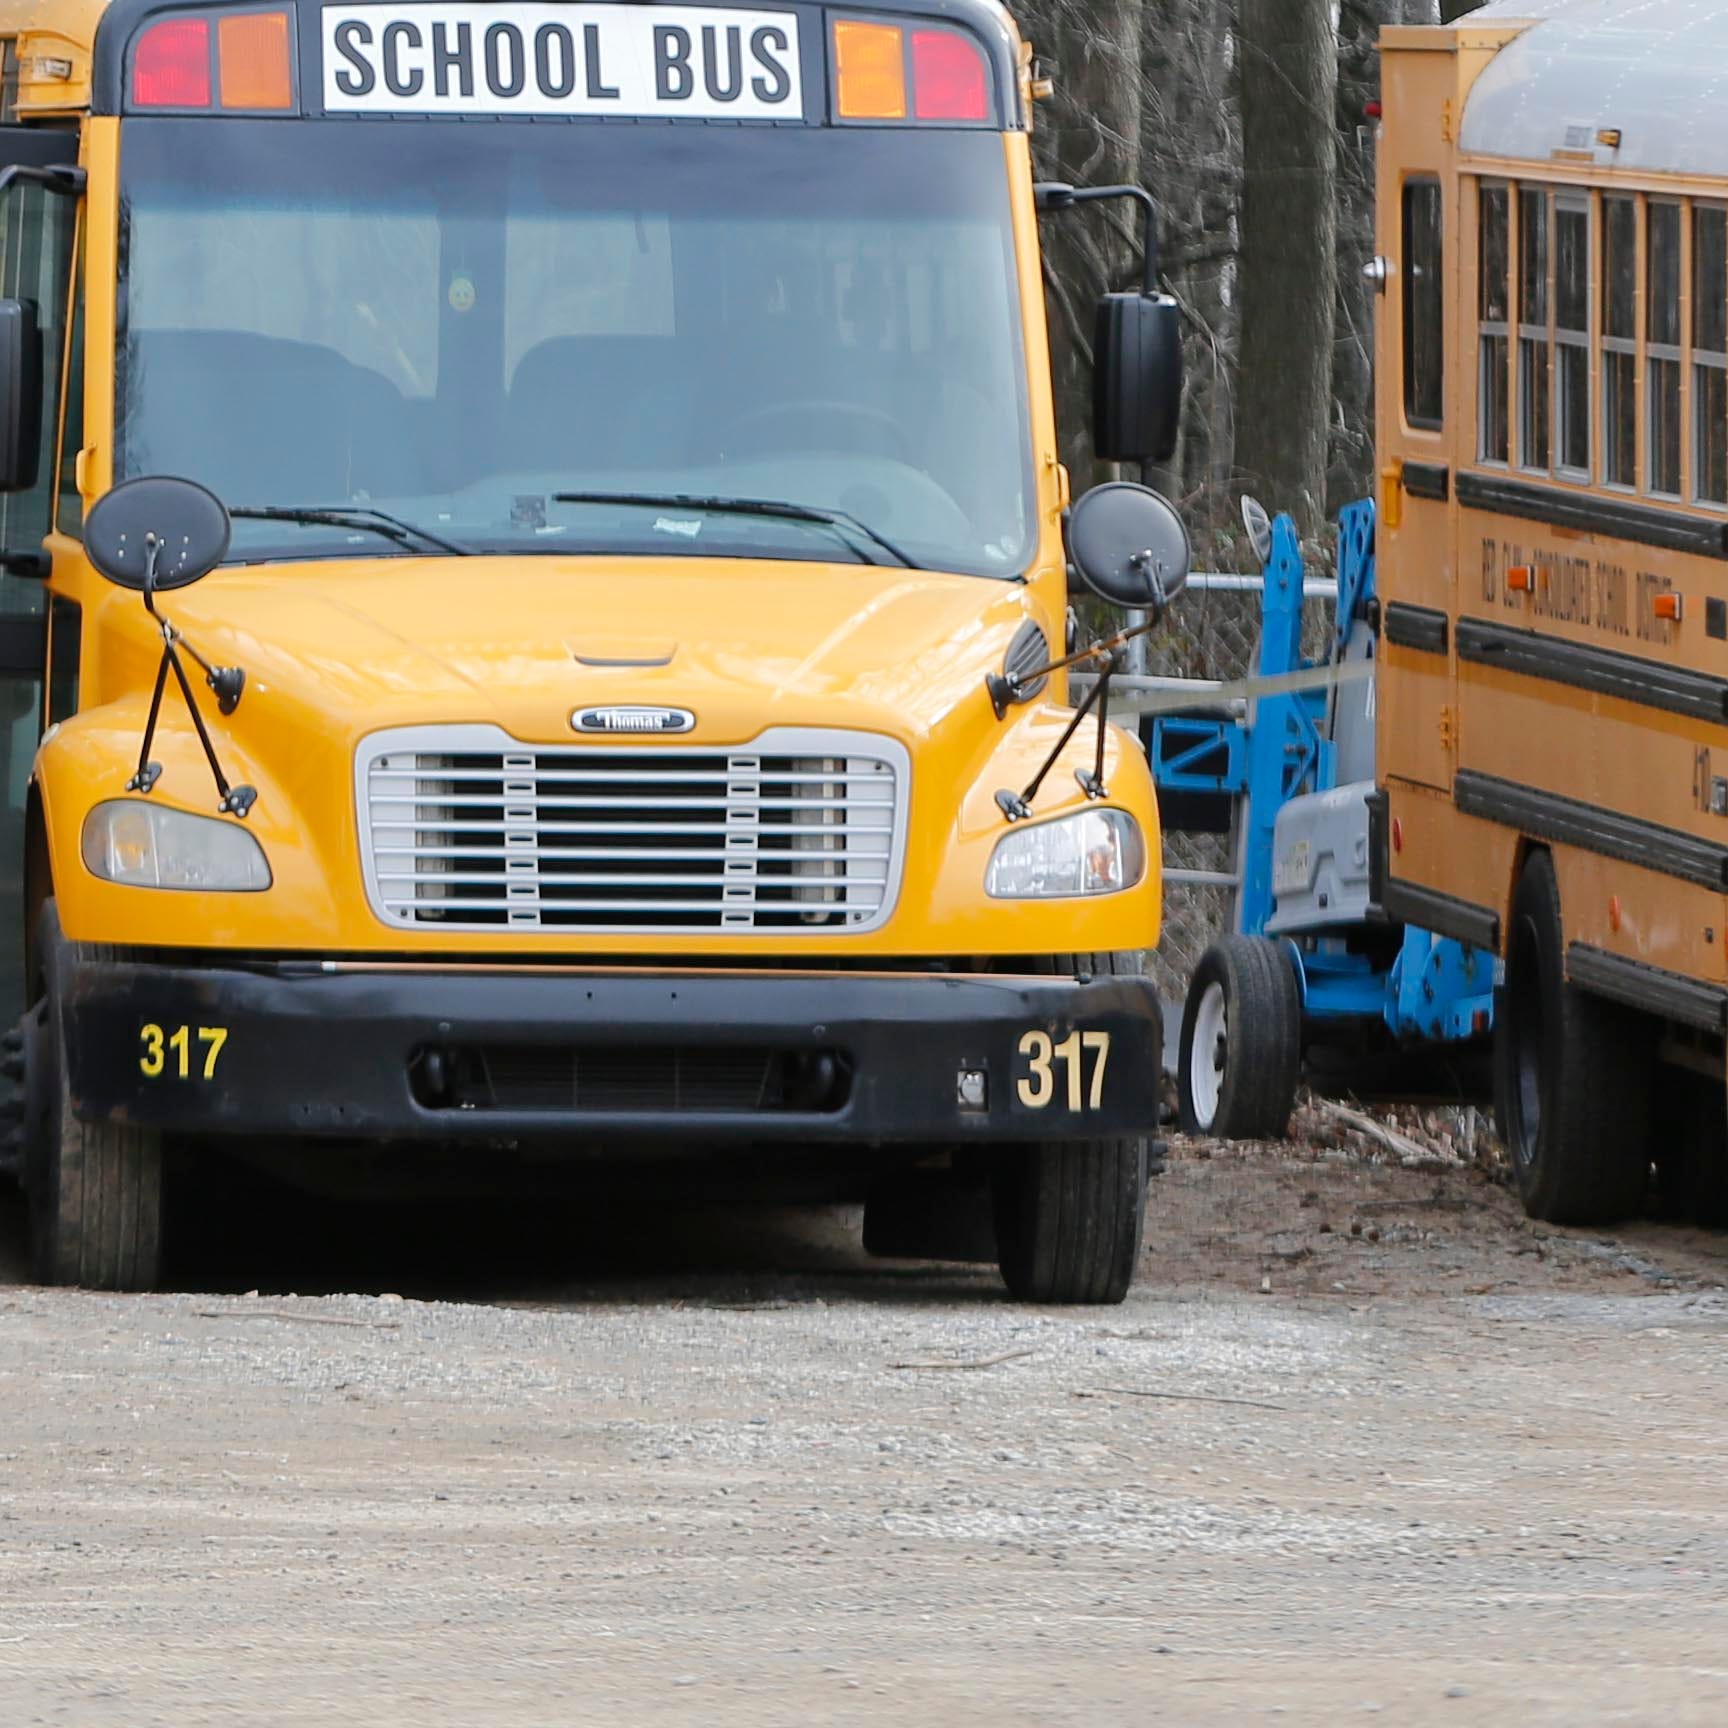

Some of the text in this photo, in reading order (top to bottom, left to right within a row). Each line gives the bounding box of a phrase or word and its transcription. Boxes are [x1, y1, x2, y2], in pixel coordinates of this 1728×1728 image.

[333, 19, 791, 103] SCHOOL BUS
[596, 709, 671, 730] Thomas
[140, 1024, 228, 1080] 317
[1017, 1030, 1110, 1112] 317
